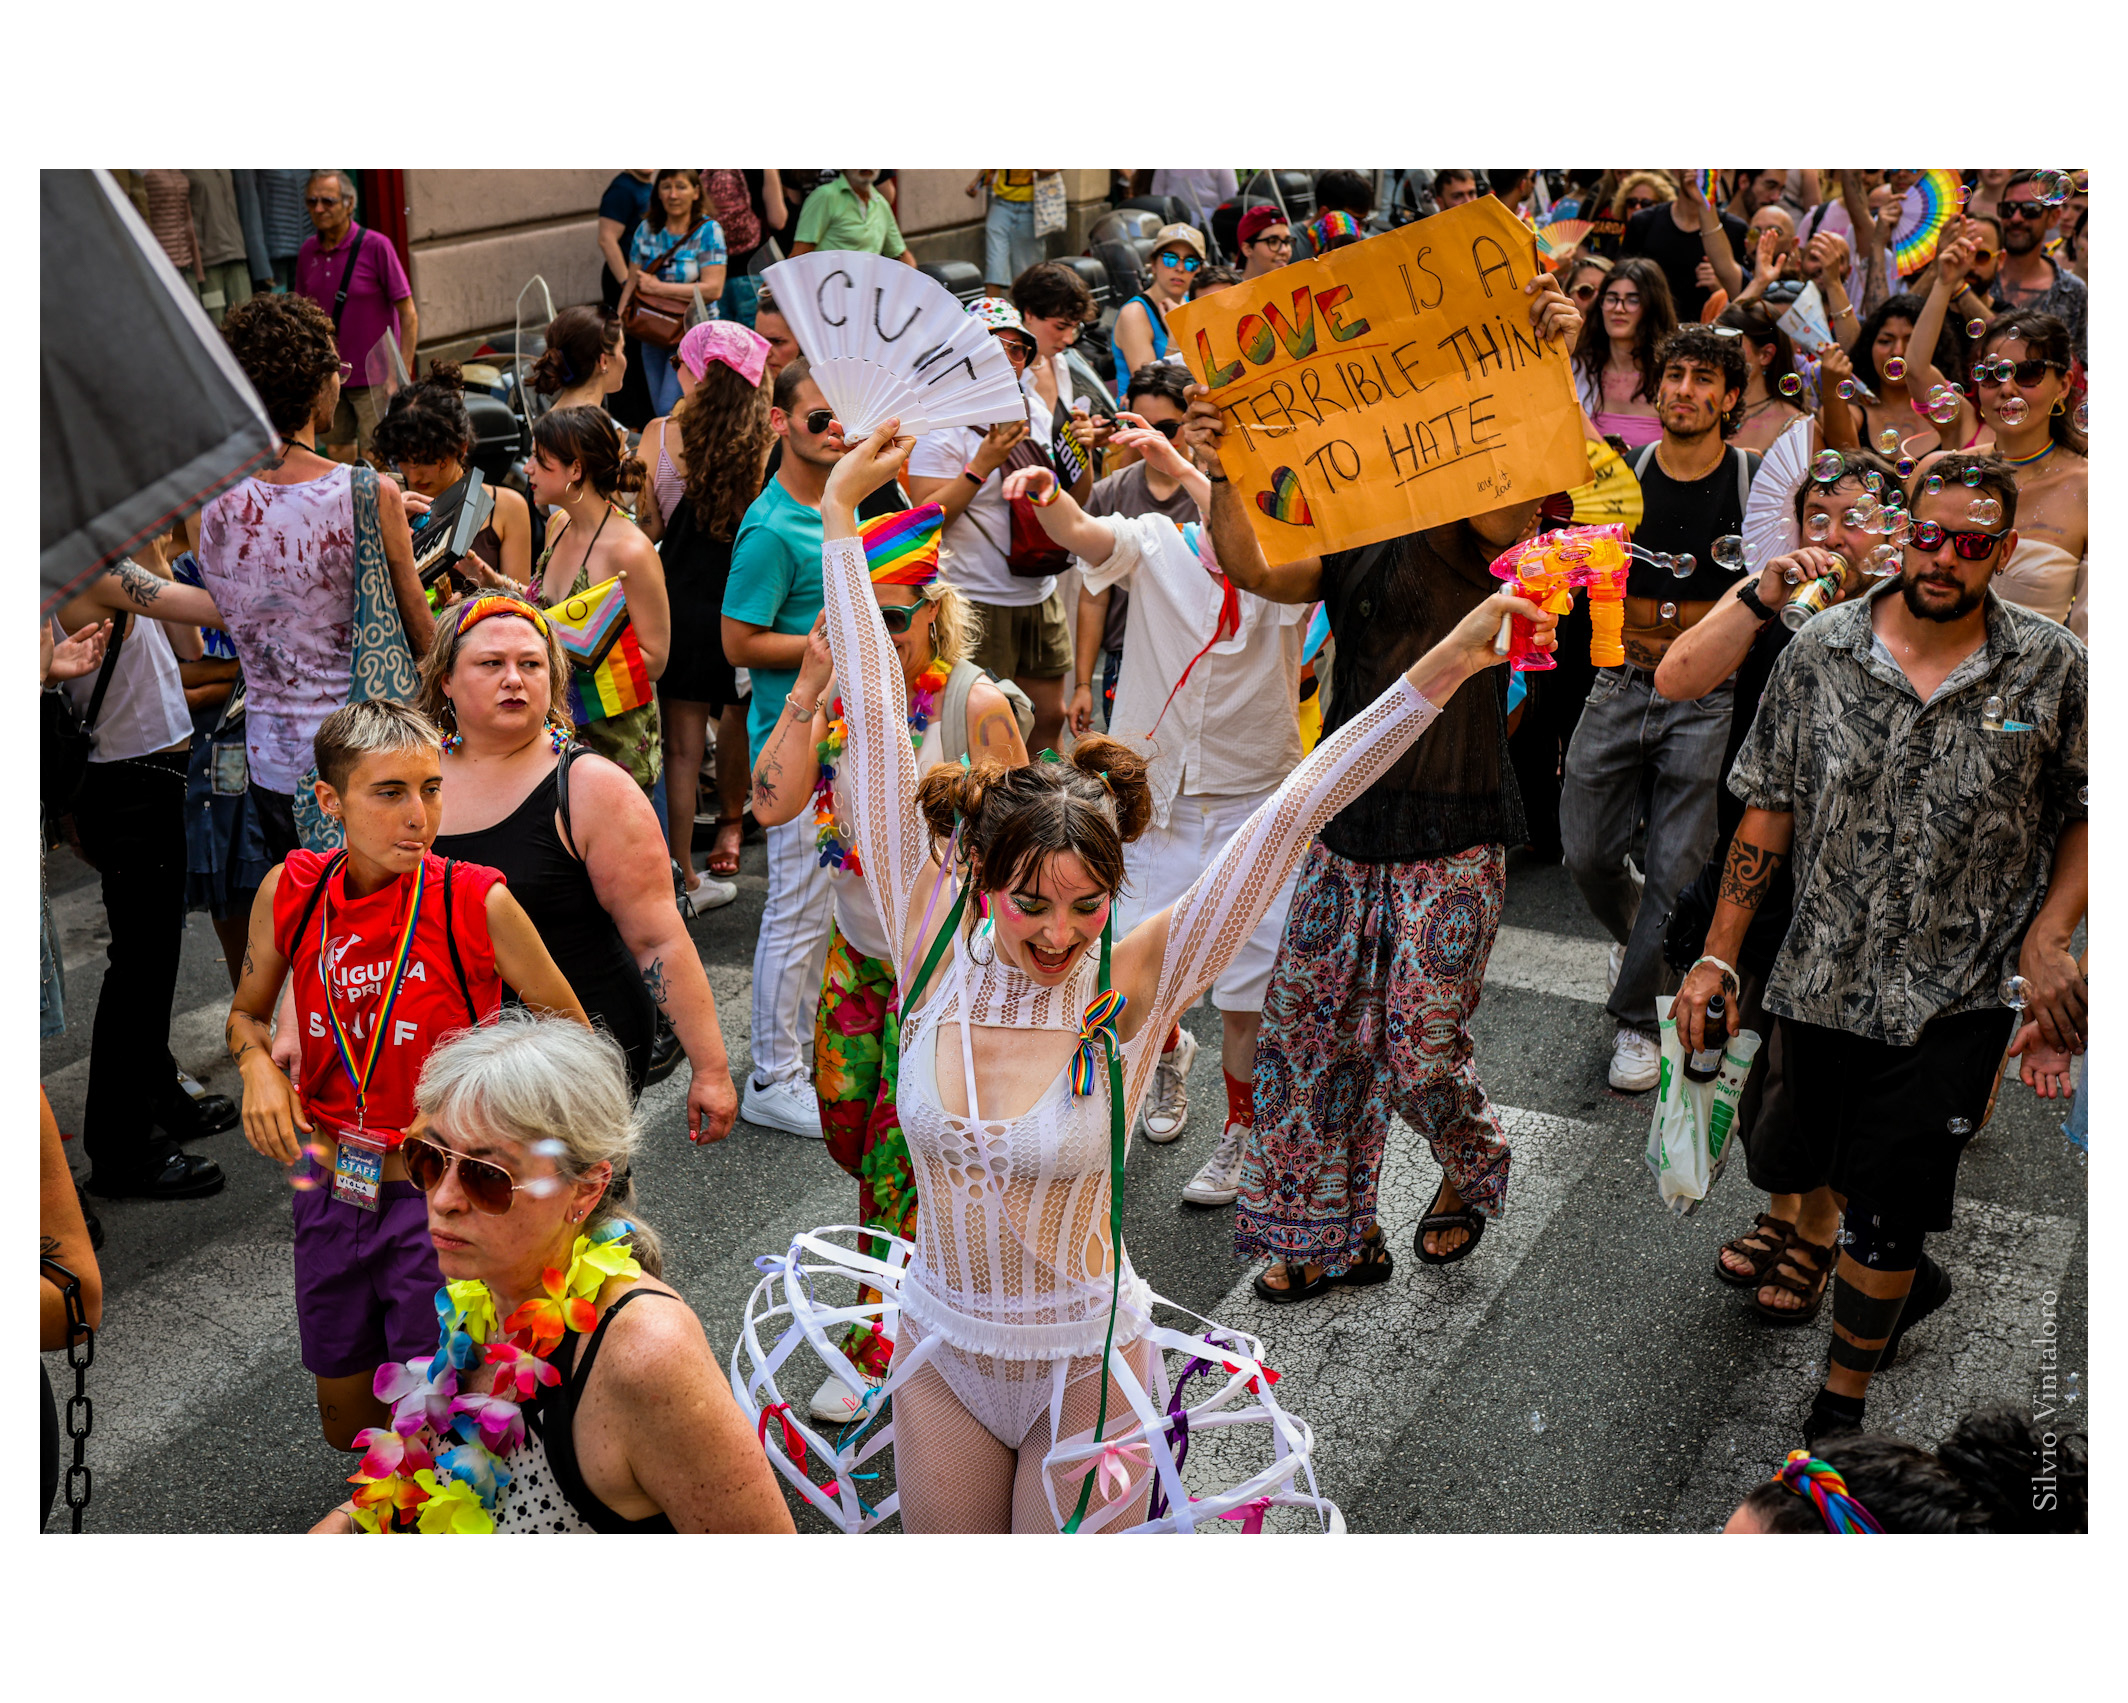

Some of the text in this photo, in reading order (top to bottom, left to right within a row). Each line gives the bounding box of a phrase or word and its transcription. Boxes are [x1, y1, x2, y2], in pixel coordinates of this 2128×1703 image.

[1196, 235, 1518, 389] LOVE IS A
[1221, 340, 1436, 452] TERRIBLE
[1304, 394, 1502, 494] TO HATE
[346, 978, 406, 1003] PRI
[308, 1011, 418, 1046] SAF
[340, 1160, 377, 1178] STAFF
